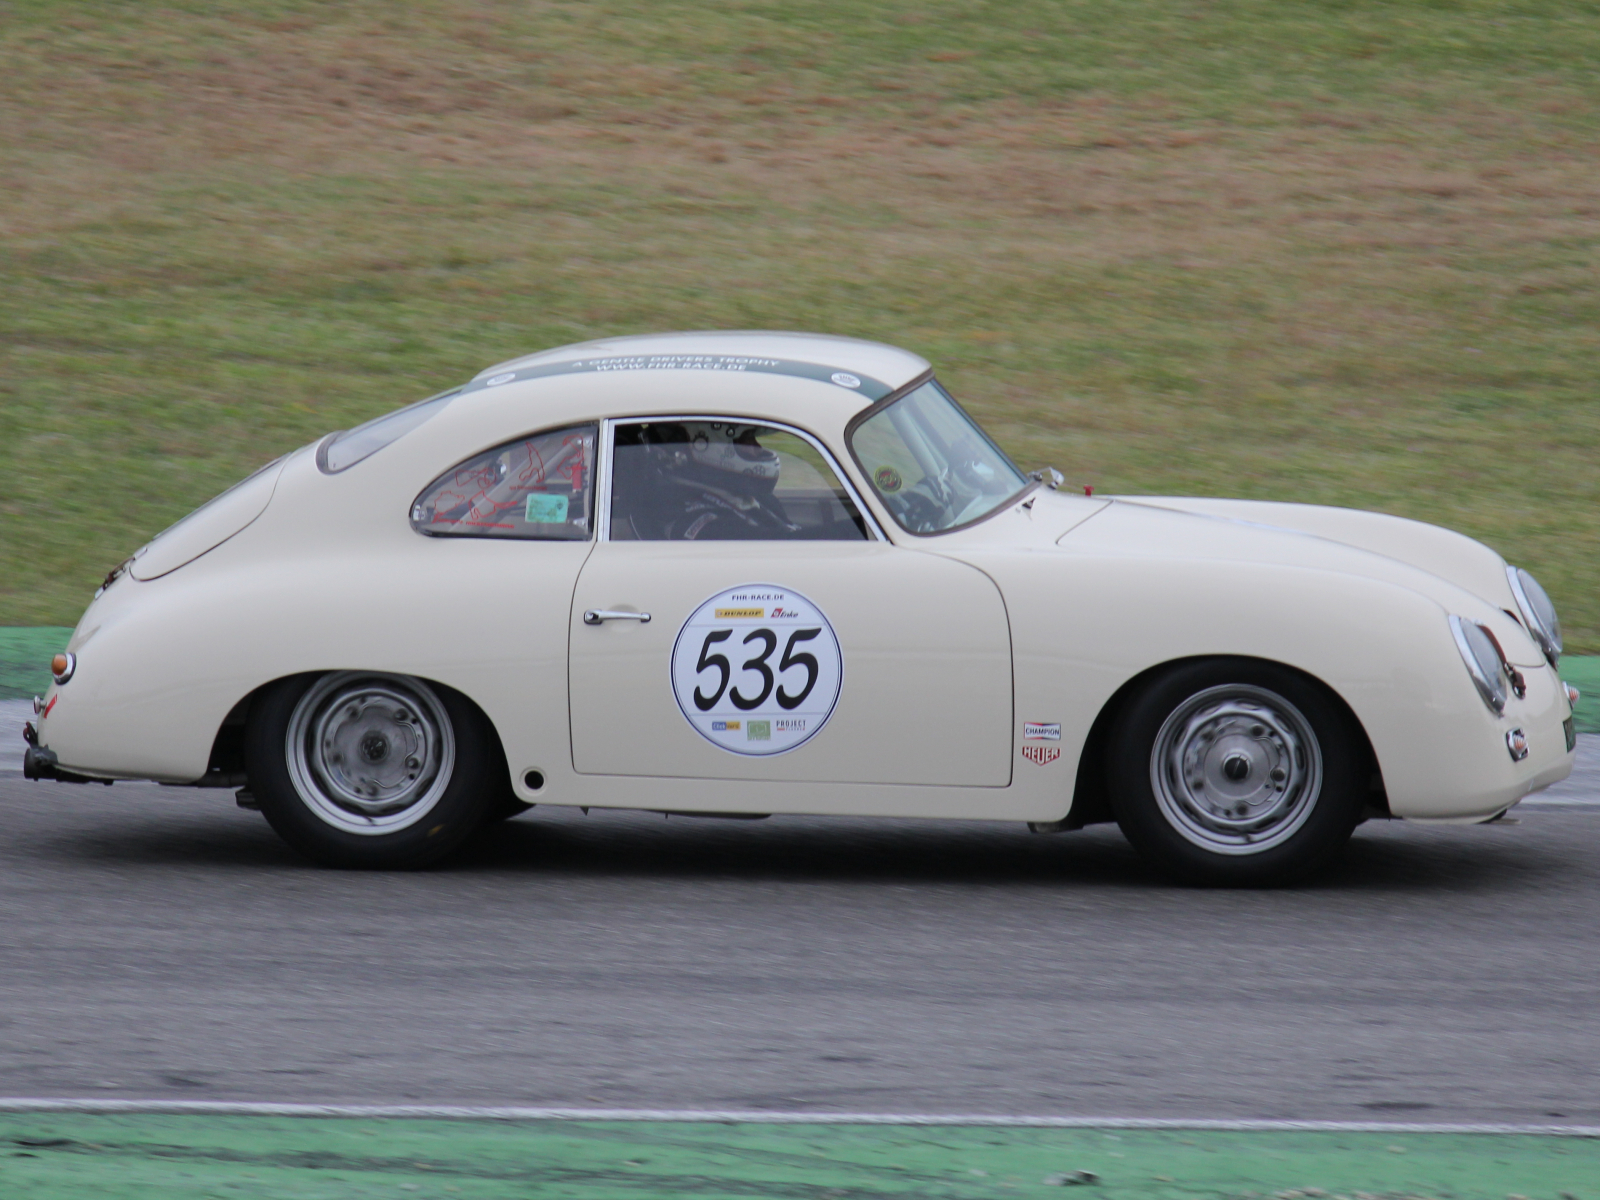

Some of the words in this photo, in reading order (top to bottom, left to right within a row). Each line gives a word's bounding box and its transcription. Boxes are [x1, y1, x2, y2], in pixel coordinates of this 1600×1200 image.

[719, 357, 779, 366] TROPHY
[596, 362, 747, 371] WWW.FHR-RACE.DE
[693, 627, 822, 712] 535
[1026, 727, 1060, 735] CHAMPION
[1023, 746, 1061, 764] HEUER
